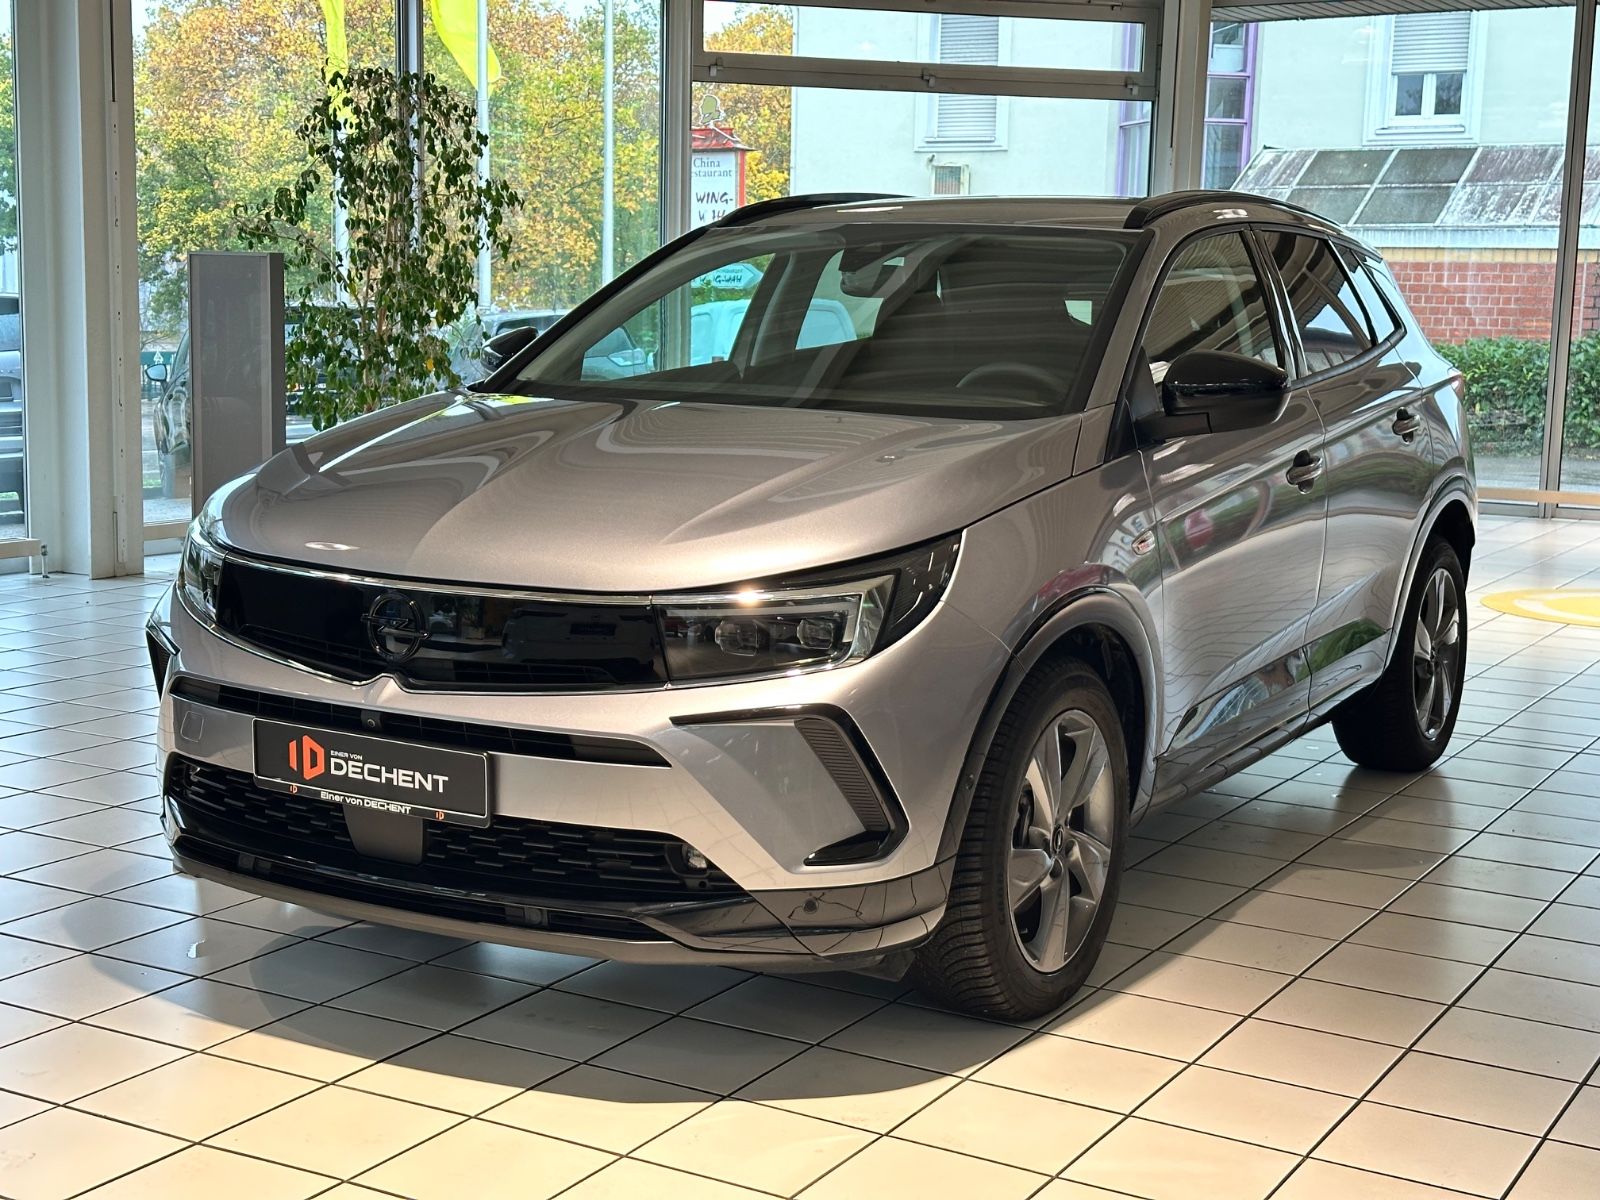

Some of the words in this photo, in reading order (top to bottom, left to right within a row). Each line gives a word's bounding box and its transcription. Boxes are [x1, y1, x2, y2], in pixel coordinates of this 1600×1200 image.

[693, 157, 721, 168] China
[692, 169, 732, 177] staurant
[695, 191, 734, 204] WING-
[330, 750, 349, 758] EINER
[349, 752, 363, 761] VON
[330, 757, 449, 793] DECHENT
[320, 790, 345, 803] Einer
[345, 796, 363, 807] von
[363, 798, 412, 815] DECHENT
